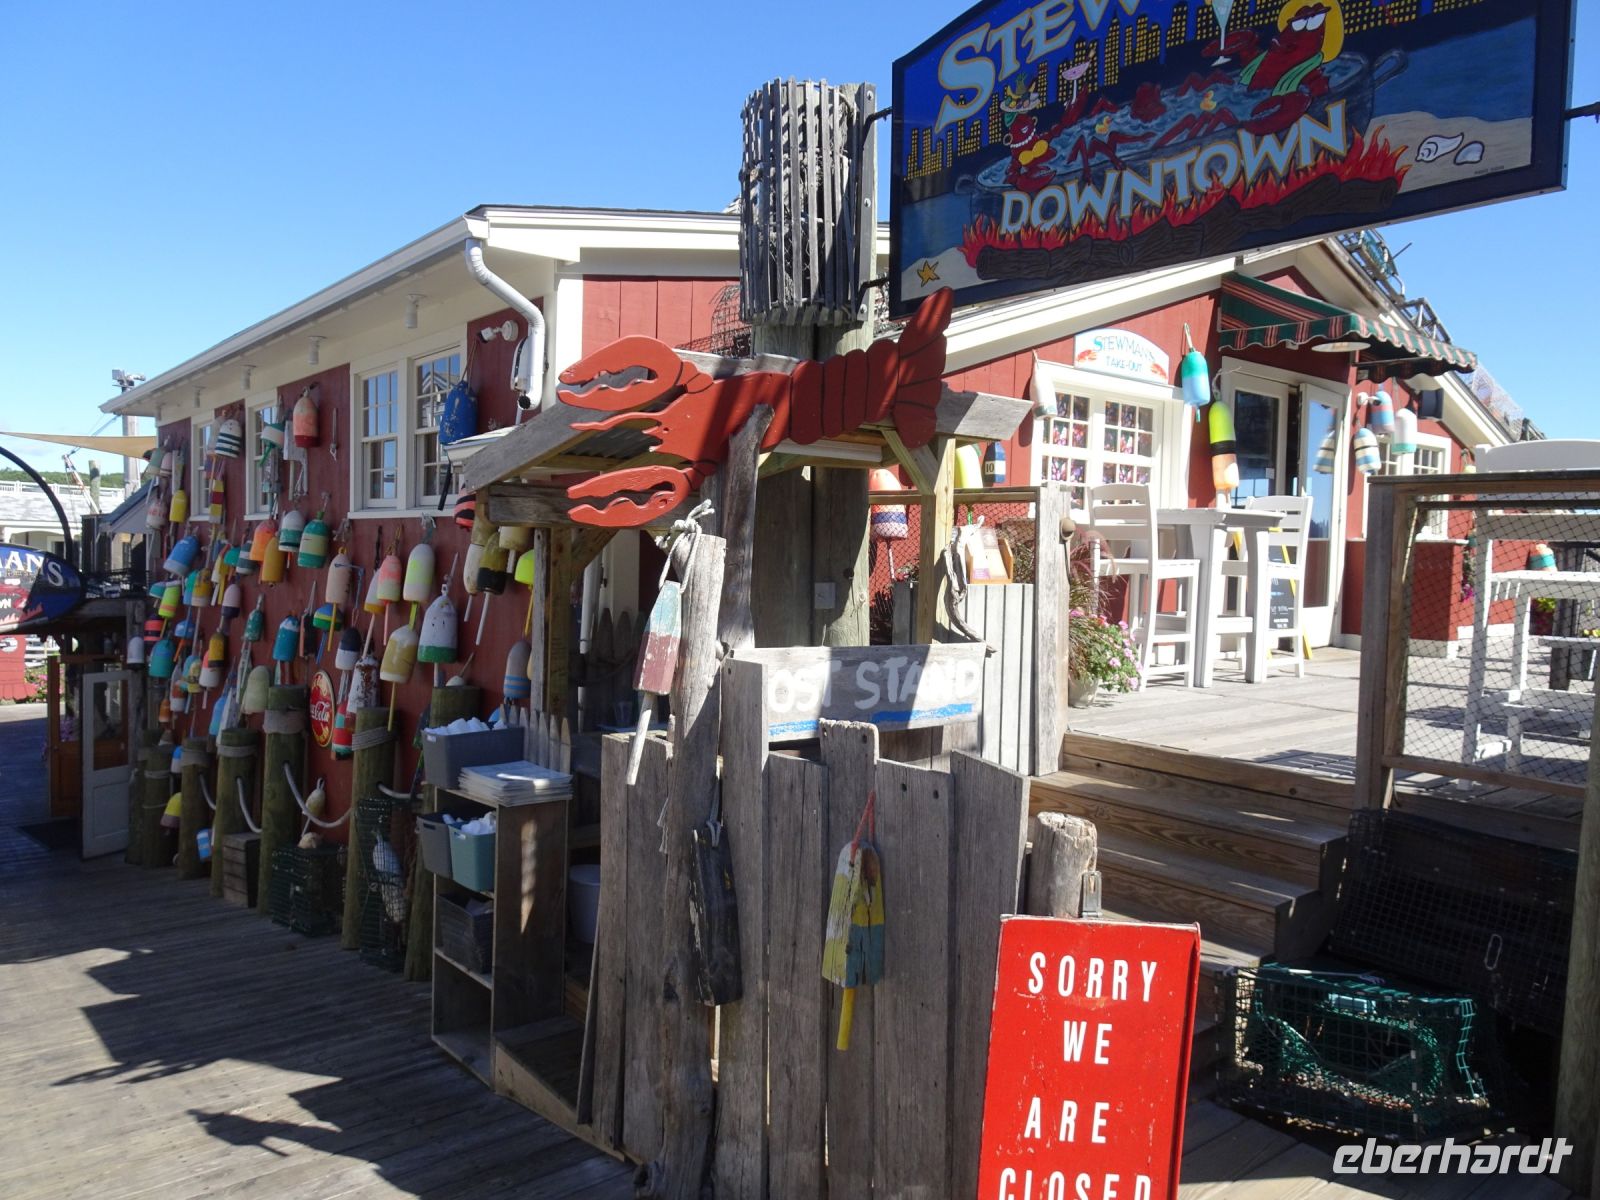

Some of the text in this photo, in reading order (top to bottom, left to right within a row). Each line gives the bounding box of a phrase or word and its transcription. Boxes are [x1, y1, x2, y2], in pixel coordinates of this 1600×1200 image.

[998, 99, 1348, 236] DOWNTOWN
[1105, 355, 1143, 372] TAKE-OUT
[0, 550, 64, 587] ANS
[768, 656, 979, 713] OST STAND
[1028, 951, 1158, 1003] SORRY
[1063, 1020, 1113, 1065] WE
[1024, 1096, 1110, 1144] ARE
[998, 1167, 1153, 1200] CLOSED
